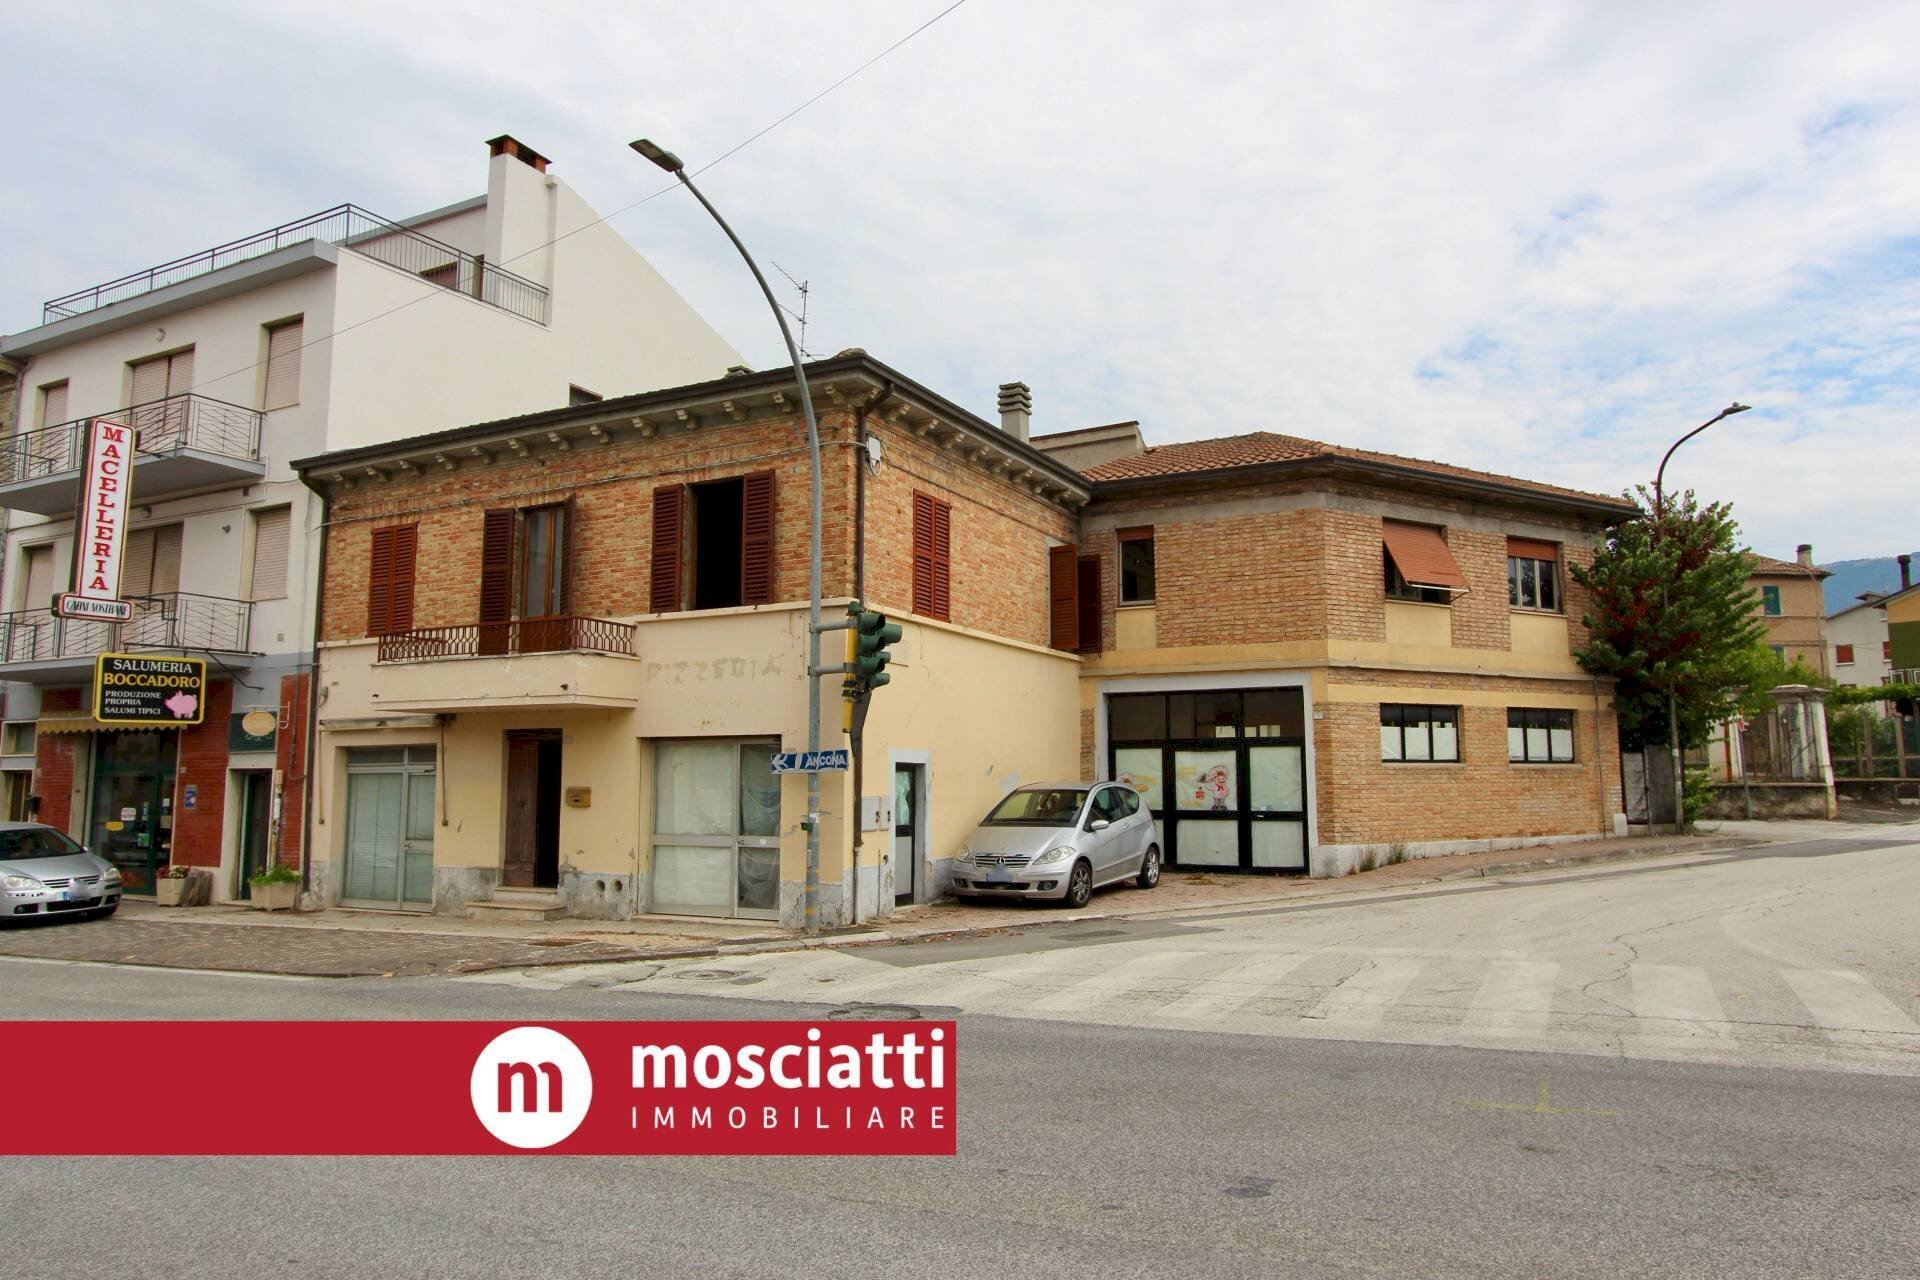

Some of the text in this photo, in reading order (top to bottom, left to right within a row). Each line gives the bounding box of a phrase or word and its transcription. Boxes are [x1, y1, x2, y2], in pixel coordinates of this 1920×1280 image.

[88, 425, 124, 591] MACELLERIA
[113, 659, 193, 674] SALUMERIA
[103, 672, 200, 688] BOCCADORO
[105, 690, 162, 699] PRODUZIONE
[104, 698, 141, 706] PROPRIA
[137, 707, 160, 715] TIPICI
[807, 754, 846, 767] ANCONA
